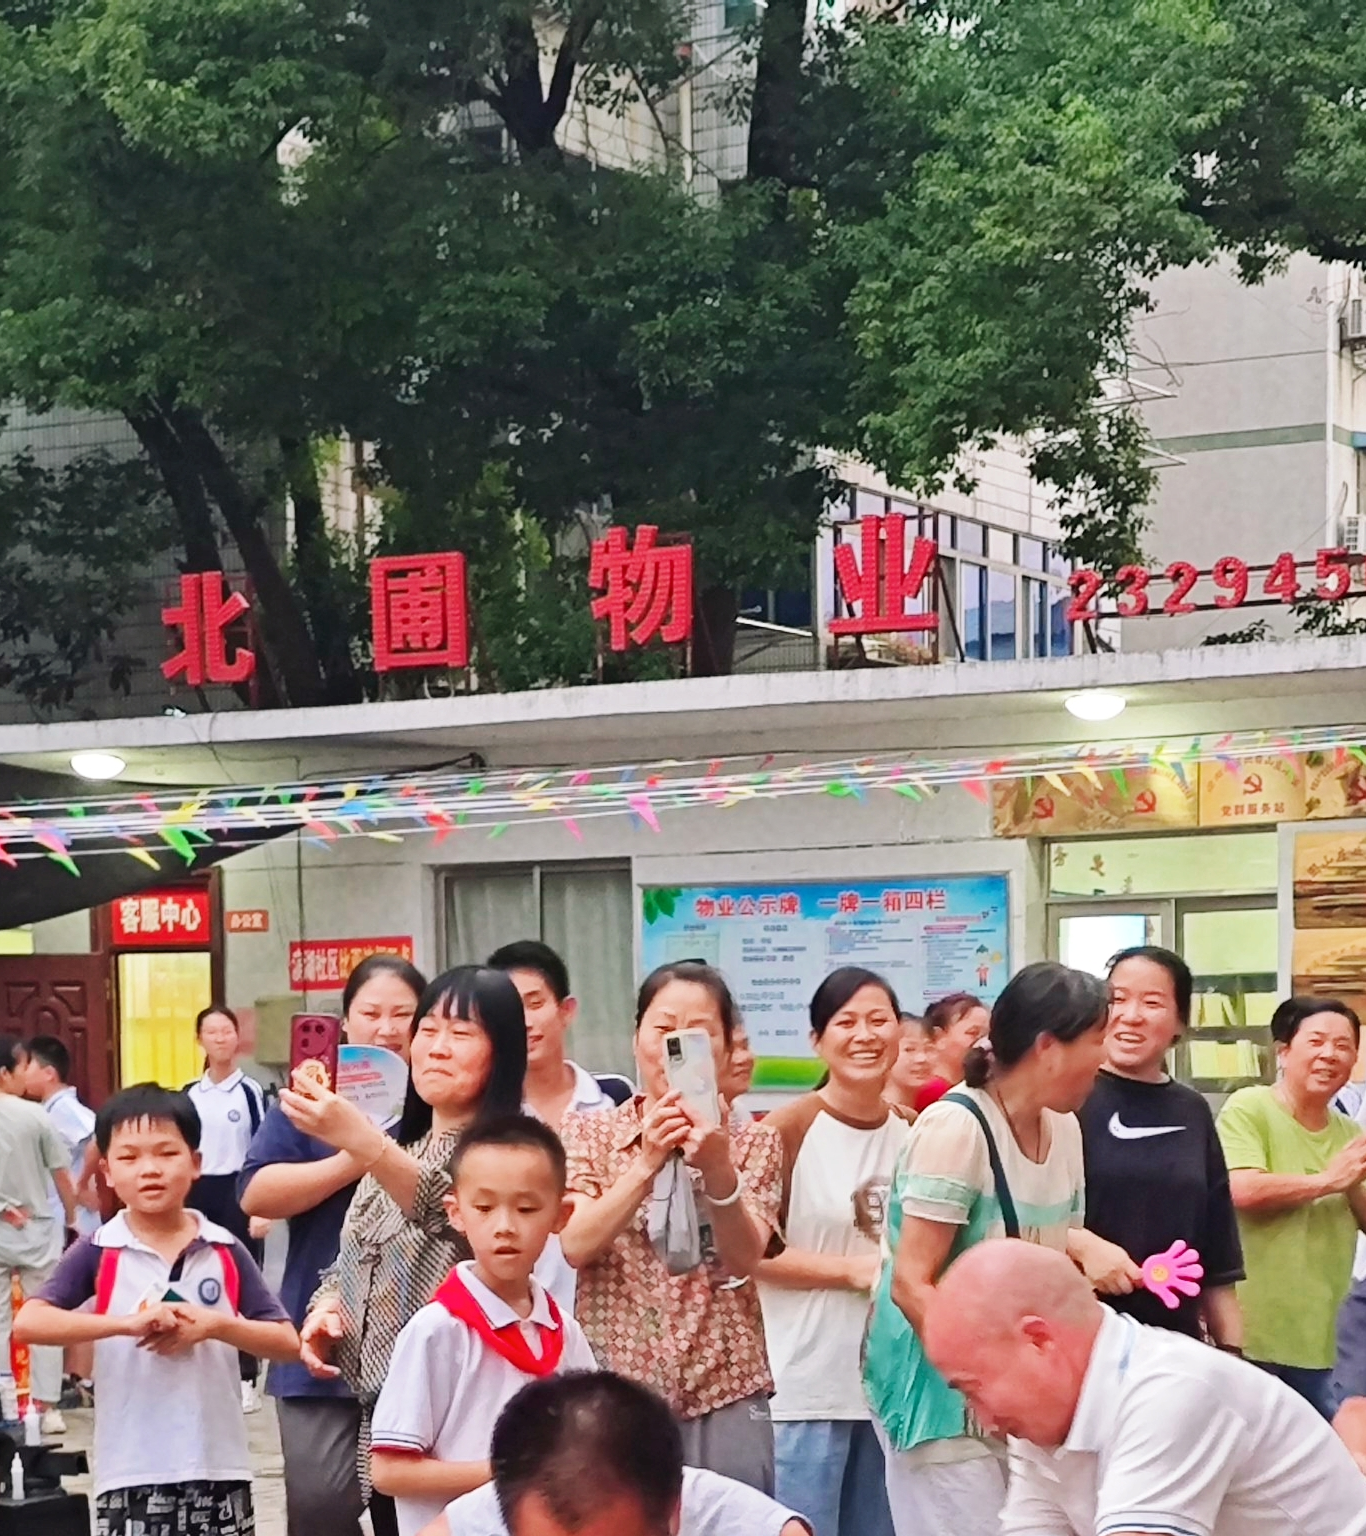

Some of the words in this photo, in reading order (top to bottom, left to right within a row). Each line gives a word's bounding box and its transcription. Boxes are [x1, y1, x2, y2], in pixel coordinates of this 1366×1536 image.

[119, 897, 202, 933] 客服中心
[695, 896, 800, 917] 物业公示牌
[819, 889, 947, 913] 一牌一箱四栏
